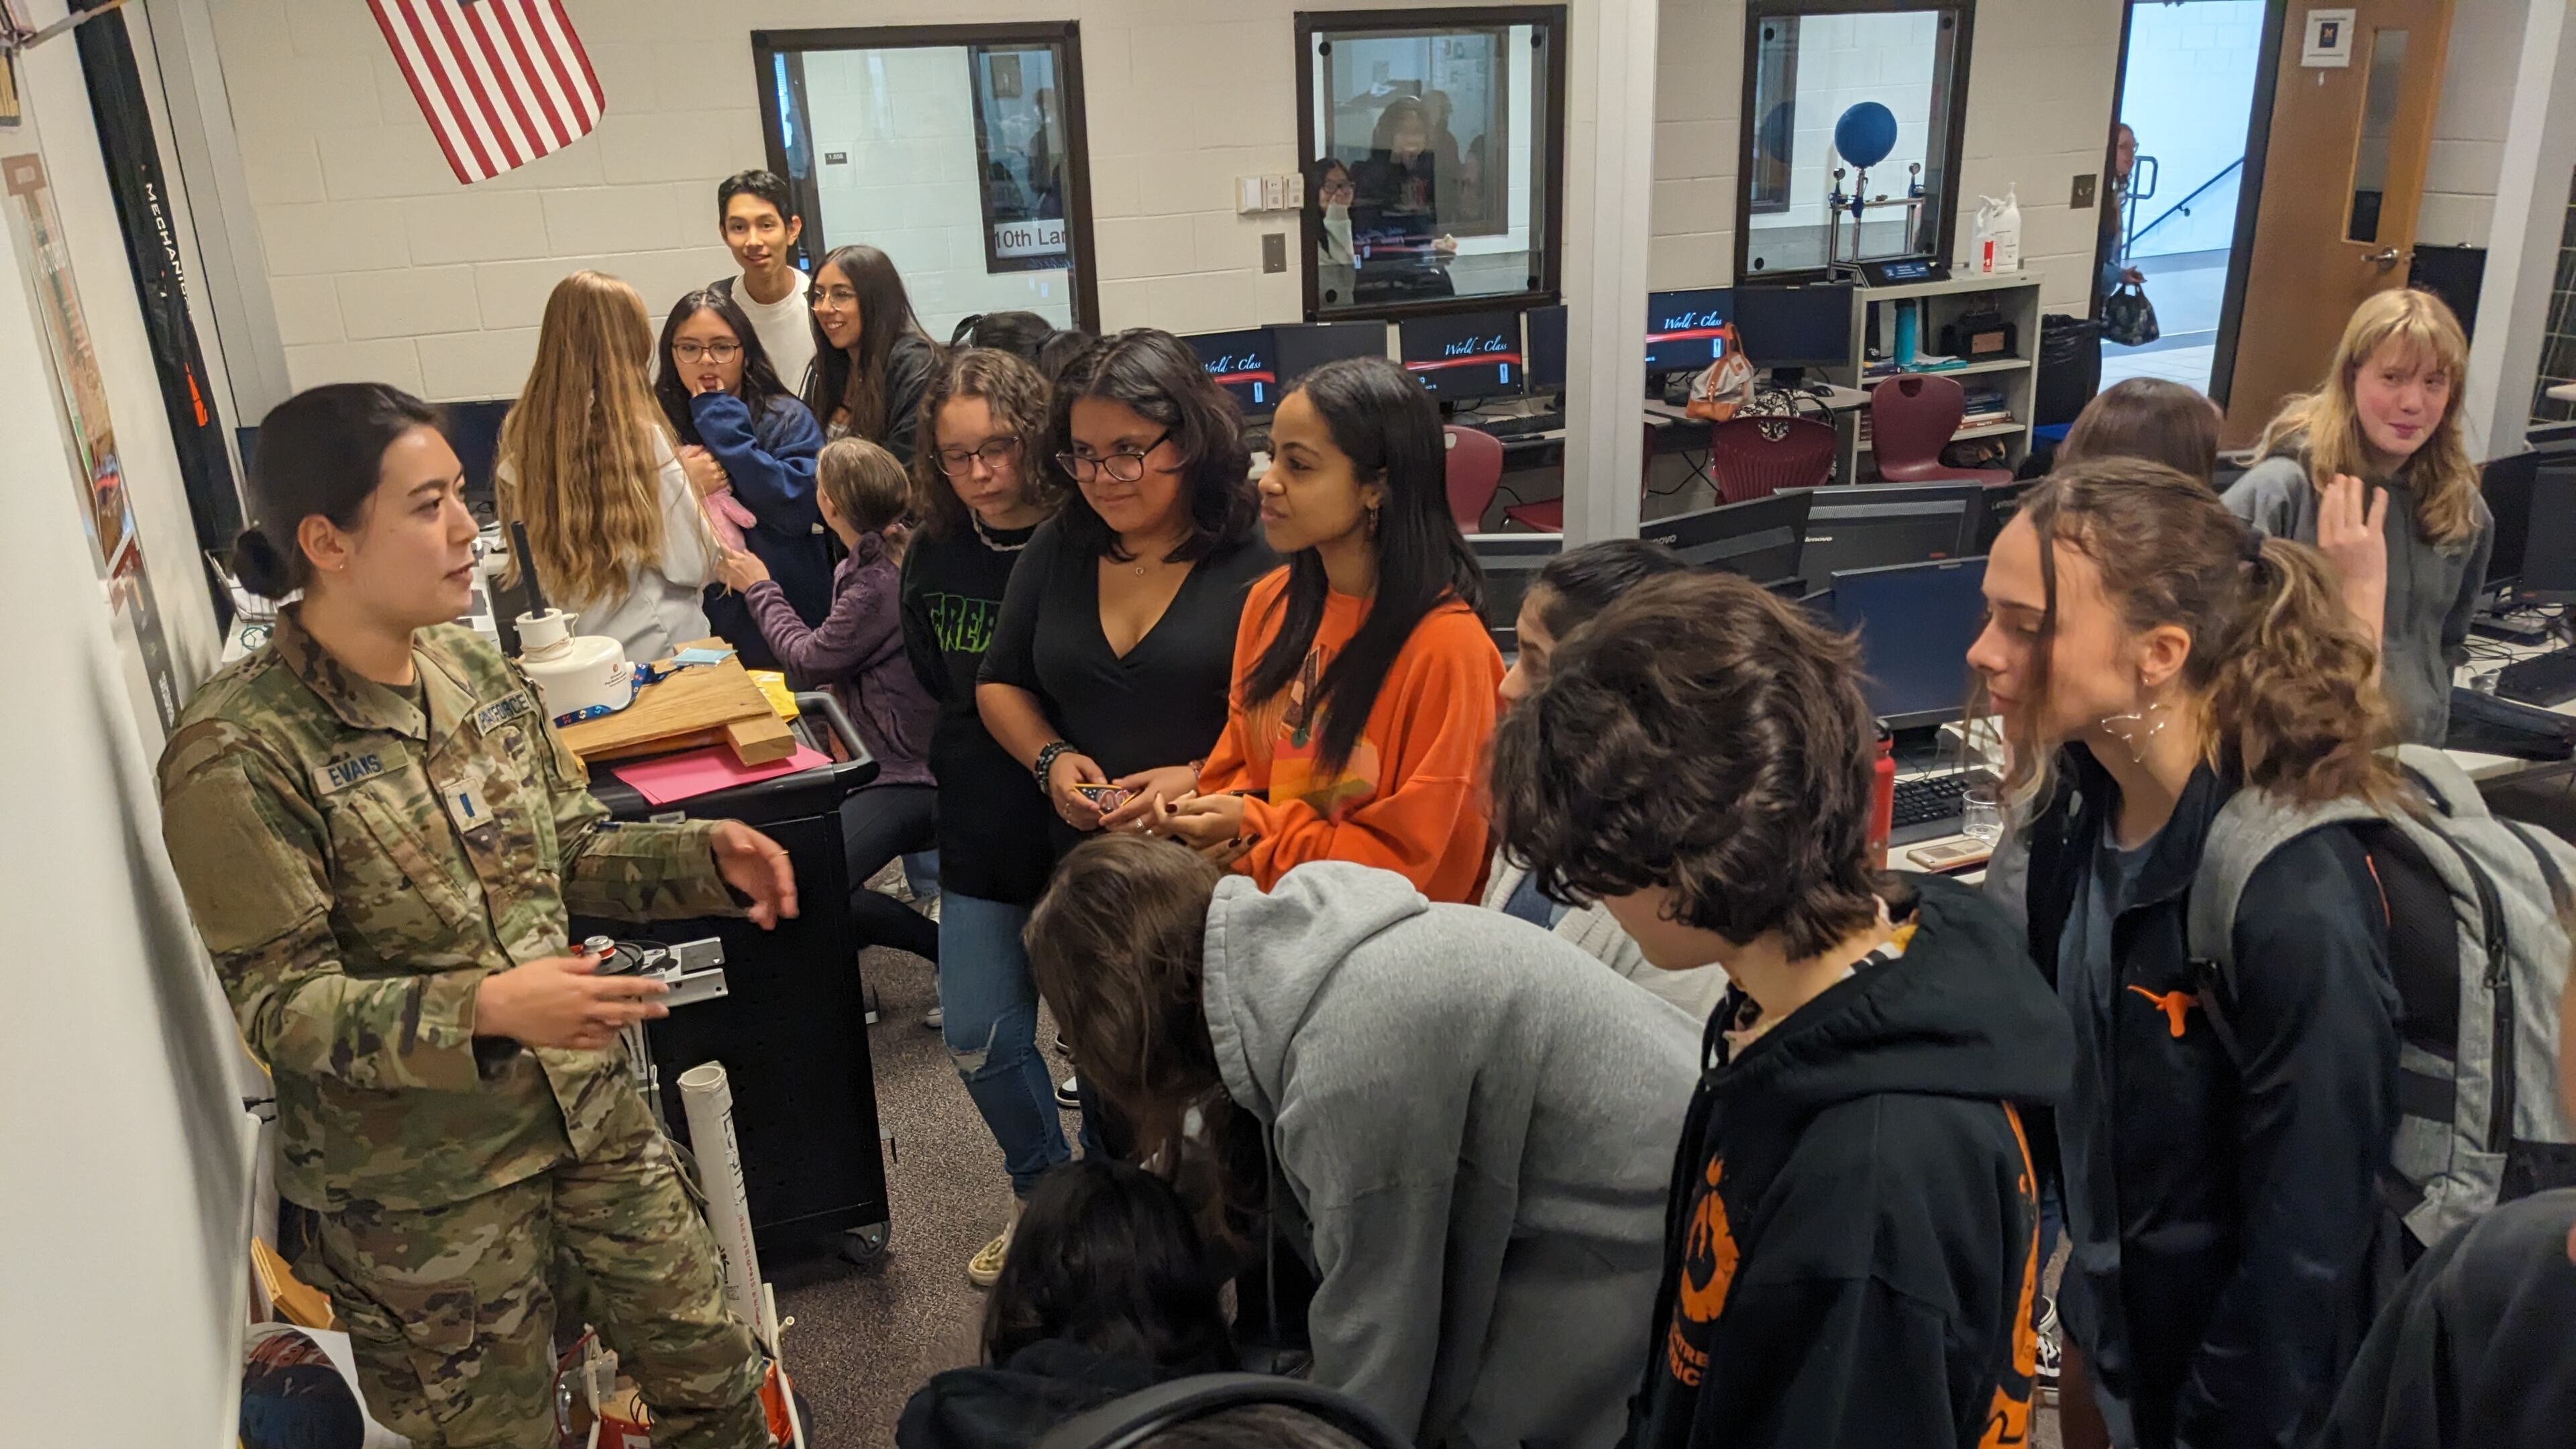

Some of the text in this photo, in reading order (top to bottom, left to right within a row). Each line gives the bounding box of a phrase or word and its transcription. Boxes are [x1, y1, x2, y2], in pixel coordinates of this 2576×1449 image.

[995, 229, 1032, 248] 10th
[1664, 312, 1697, 329] World
[1701, 311, 1722, 327] Class
[1445, 336, 1479, 356] World
[1484, 335, 1507, 352] Class
[1238, 353, 1261, 370] Class
[328, 754, 383, 788] EVANS
